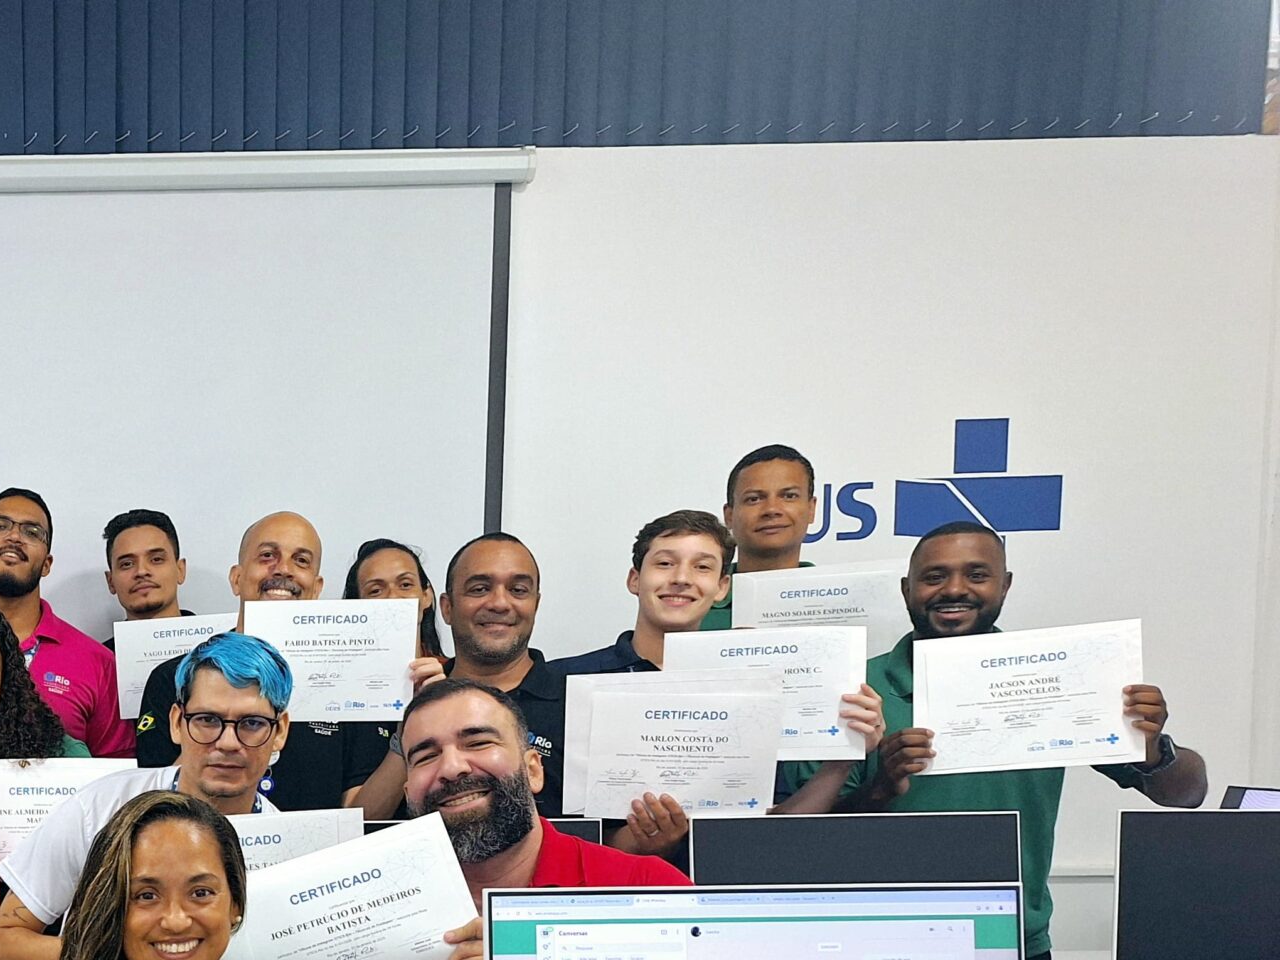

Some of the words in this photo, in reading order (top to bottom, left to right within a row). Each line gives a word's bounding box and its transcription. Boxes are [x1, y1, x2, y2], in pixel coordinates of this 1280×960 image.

[780, 587, 849, 599] CERTIFICADO
[761, 611, 791, 619] MAGNO
[792, 609, 822, 617] SOARES
[823, 606, 865, 615] ESPINDOLA
[292, 614, 368, 625] CERTIFICADO
[152, 626, 214, 639] CERTIFICADO
[284, 639, 310, 647] FABIO
[312, 639, 347, 647] BATISTA
[349, 638, 375, 646] PINTO
[143, 649, 163, 657] YAGO
[720, 644, 799, 658] CERTIFICADO
[980, 651, 1067, 669] CERTIFICADO
[784, 666, 811, 675] RONE
[54, 675, 70, 686] Rio
[988, 679, 1026, 690] JACSON
[1027, 675, 1062, 687] ANDRÉ
[990, 686, 1062, 699] VASCONCELOS
[644, 709, 729, 721] CERTIFICADO
[314, 728, 332, 736] SAÚDE
[785, 728, 798, 736] Rio
[535, 736, 552, 748] Rio
[640, 734, 680, 744] MARLON
[682, 735, 714, 744] COSTA
[715, 735, 729, 743] DO
[1058, 738, 1074, 747] Rio
[653, 744, 714, 753] NASCIMENTO
[8, 786, 77, 796] CERTIFICADO
[706, 800, 719, 808] Rio
[13, 808, 50, 816] ALMEIDA
[289, 867, 382, 906] CERTIFICADO
[271, 925, 294, 941] JOSÉ
[295, 909, 348, 936] PETRÚCIO
[350, 904, 365, 916] DE
[365, 886, 422, 911] MEDEIROS
[327, 915, 371, 935] BATISTA
